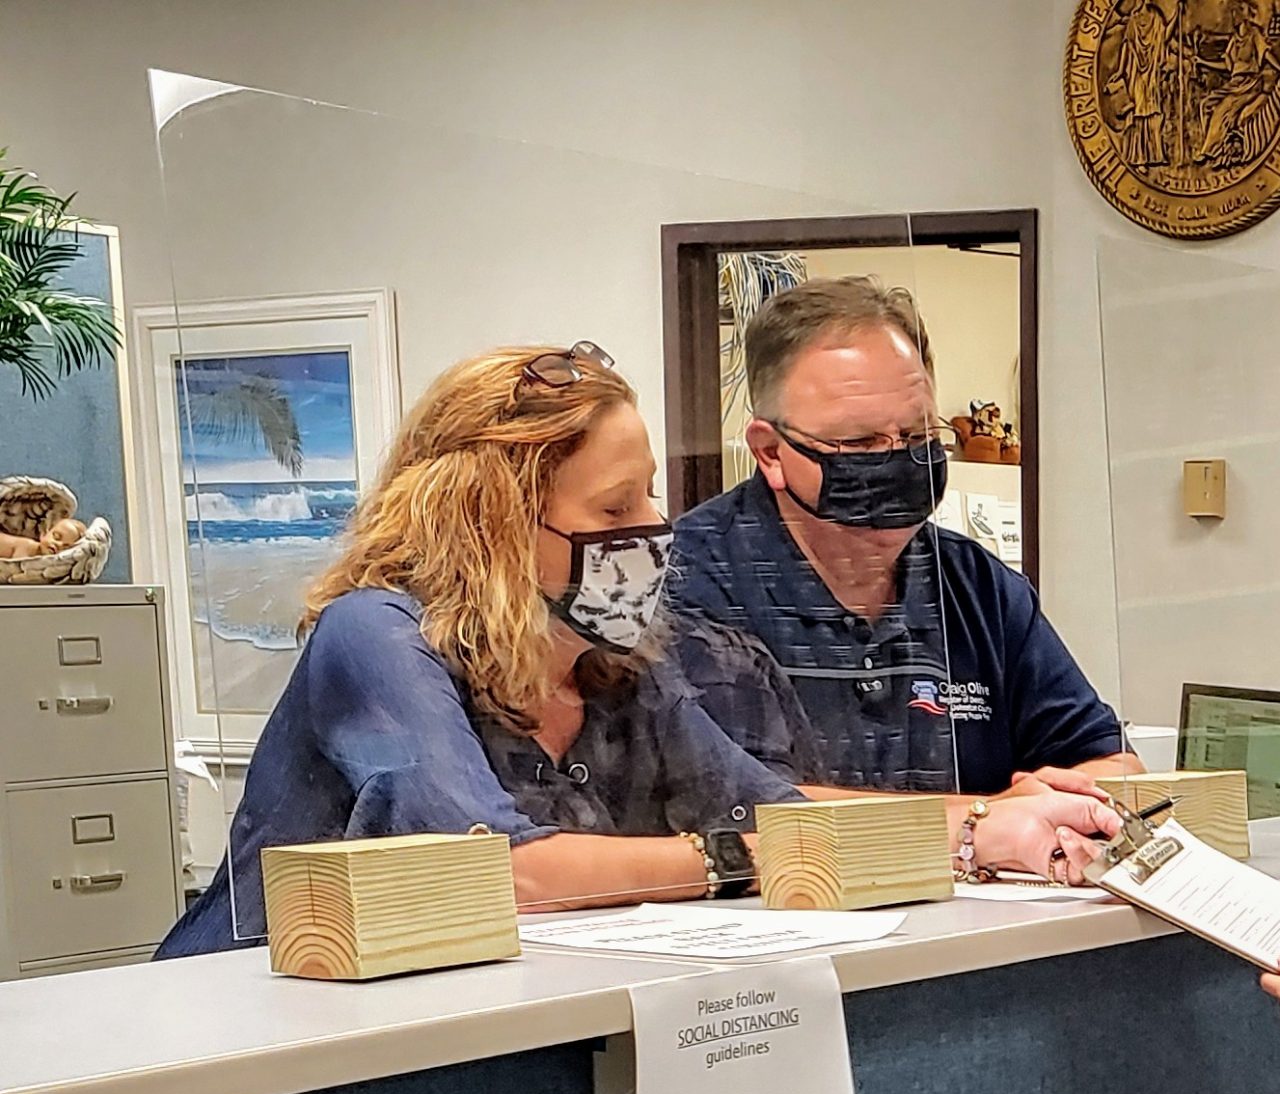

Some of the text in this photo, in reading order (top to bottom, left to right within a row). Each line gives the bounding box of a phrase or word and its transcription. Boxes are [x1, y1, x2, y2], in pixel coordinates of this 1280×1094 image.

[1069, 44, 1100, 139] GREAT
[1085, 135, 1126, 193] THE
[939, 682, 967, 696] Craig
[698, 990, 775, 1016] Please follow
[678, 1008, 799, 1047] SOCIAL DISTANCING
[706, 1041, 770, 1068] guidelines
